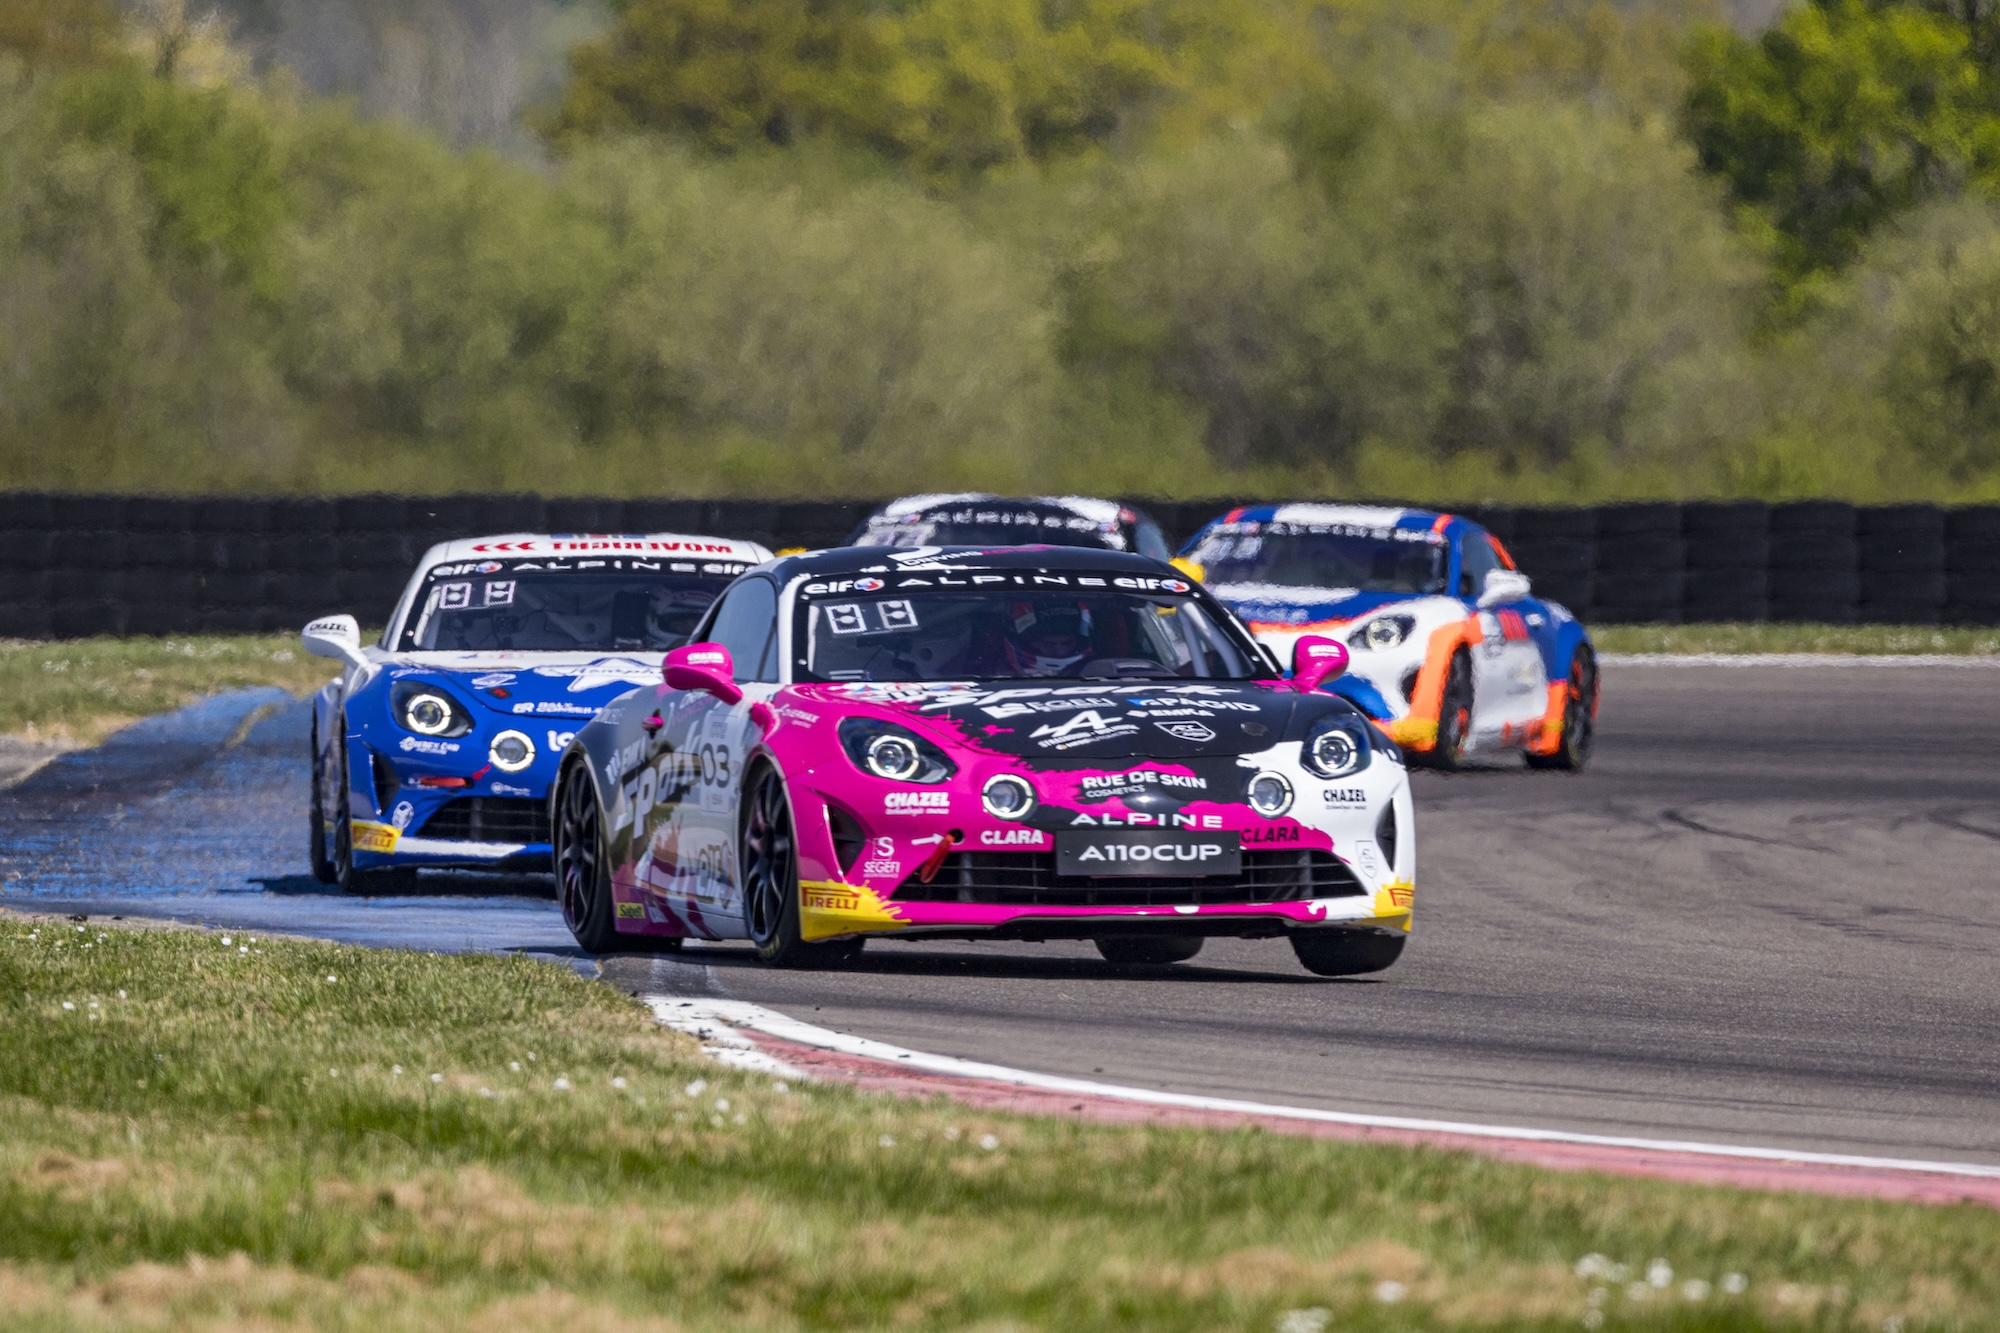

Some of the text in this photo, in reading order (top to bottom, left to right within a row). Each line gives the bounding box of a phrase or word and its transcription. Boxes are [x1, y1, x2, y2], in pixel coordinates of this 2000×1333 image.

[512, 560, 696, 573] ALPINE
[804, 580, 854, 594] elf
[897, 574, 1107, 588] ALPINE
[1113, 577, 1162, 590] elf
[1155, 697, 1261, 712] PAGID
[700, 742, 731, 788] 03
[1082, 771, 1207, 789] RUE DE SKIN
[884, 791, 950, 807] CHAZEL
[1085, 785, 1146, 798] COSMETICS
[1323, 789, 1366, 802] CHAZEL
[1070, 812, 1223, 828] ALPINE
[352, 825, 394, 848] PRELLI
[980, 830, 1044, 844] CLARA
[1241, 826, 1299, 843] CLARA
[1078, 844, 1222, 861] A110CUP
[863, 861, 901, 874] SEGEFI
[801, 886, 861, 911] PIRELLI
